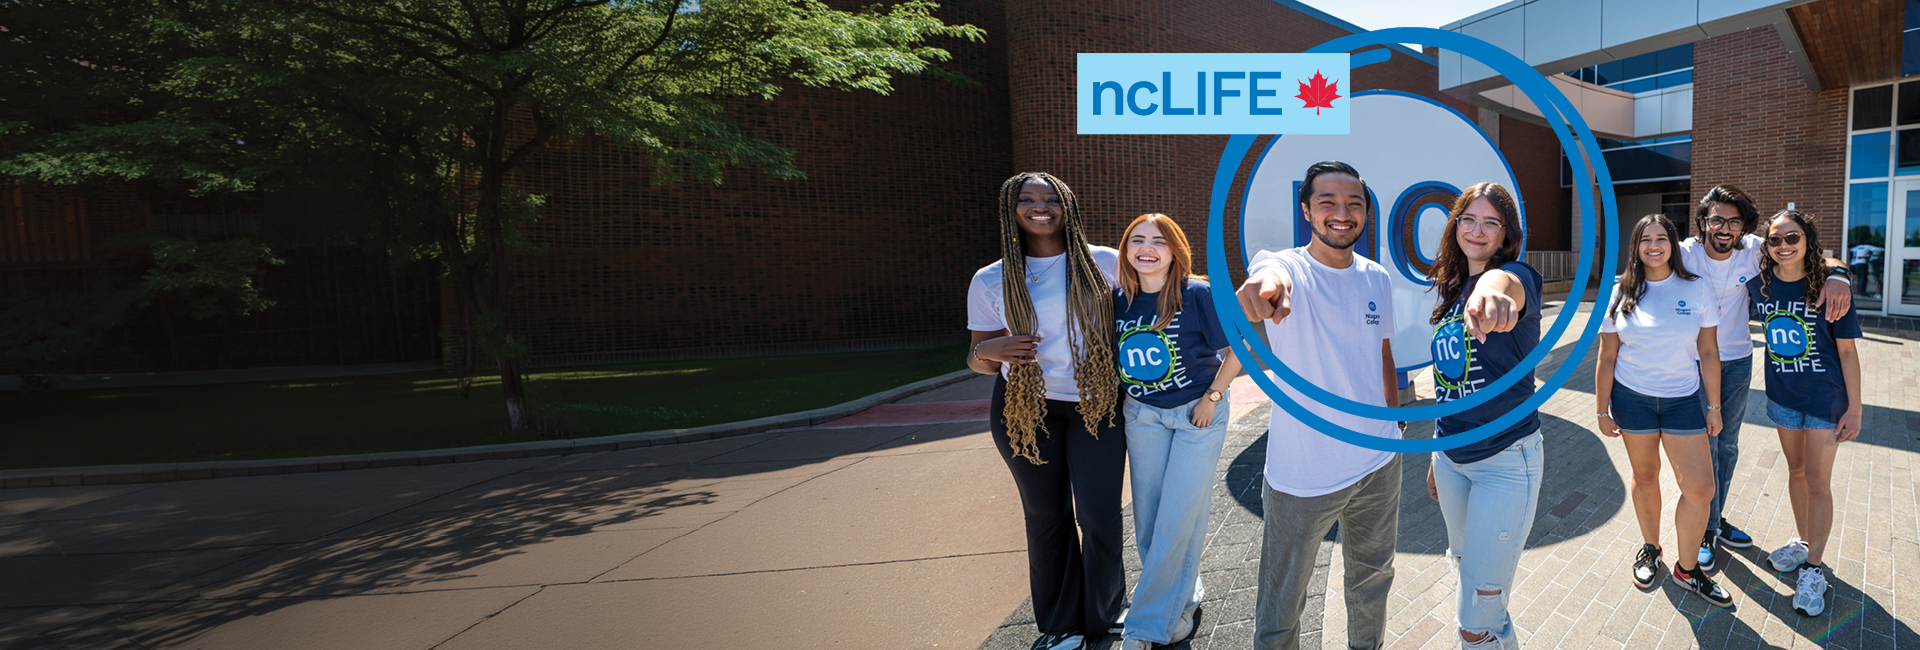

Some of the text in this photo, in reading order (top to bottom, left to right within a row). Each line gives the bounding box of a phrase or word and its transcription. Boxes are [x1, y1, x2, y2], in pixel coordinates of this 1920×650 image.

[1756, 301, 1818, 318] ncLIFE
[1115, 311, 1182, 332] ncLIE
[1771, 328, 1801, 345] nc
[1127, 347, 1162, 367] nc
[1436, 335, 1460, 361] nc
